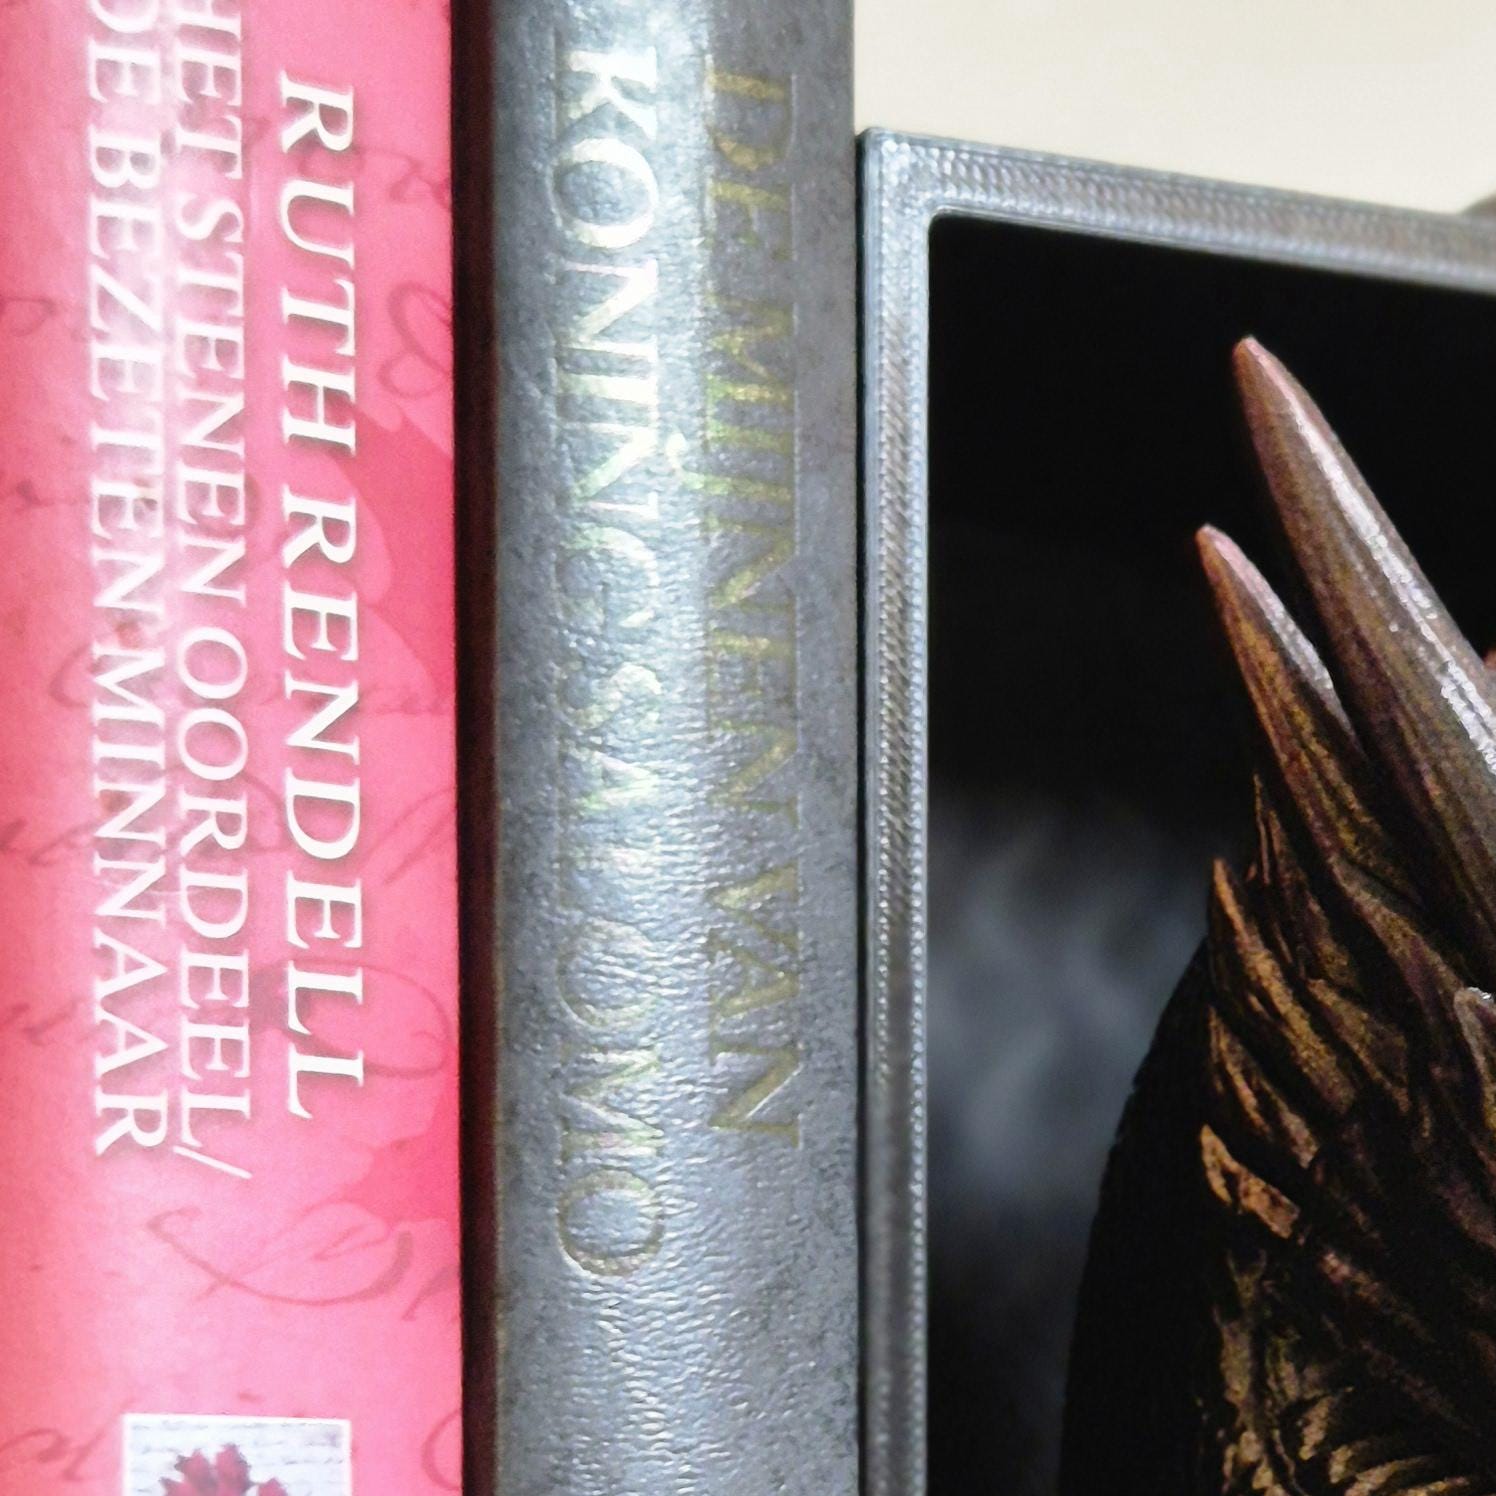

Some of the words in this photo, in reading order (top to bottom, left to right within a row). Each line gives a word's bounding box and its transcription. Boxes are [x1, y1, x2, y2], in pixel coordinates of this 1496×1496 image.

[88, 124, 166, 624] BEZETEN
[173, 195, 247, 607] STENEN
[279, 69, 356, 457] RUTH
[552, 40, 658, 632] KONING
[705, 55, 797, 262] DE
[281, 484, 364, 1119] RENDELL
[668, 290, 800, 828] MIJNEN
[93, 640, 169, 1157] MINNAAR
[555, 652, 662, 1277] SALOMO
[705, 857, 803, 1148] VAN
